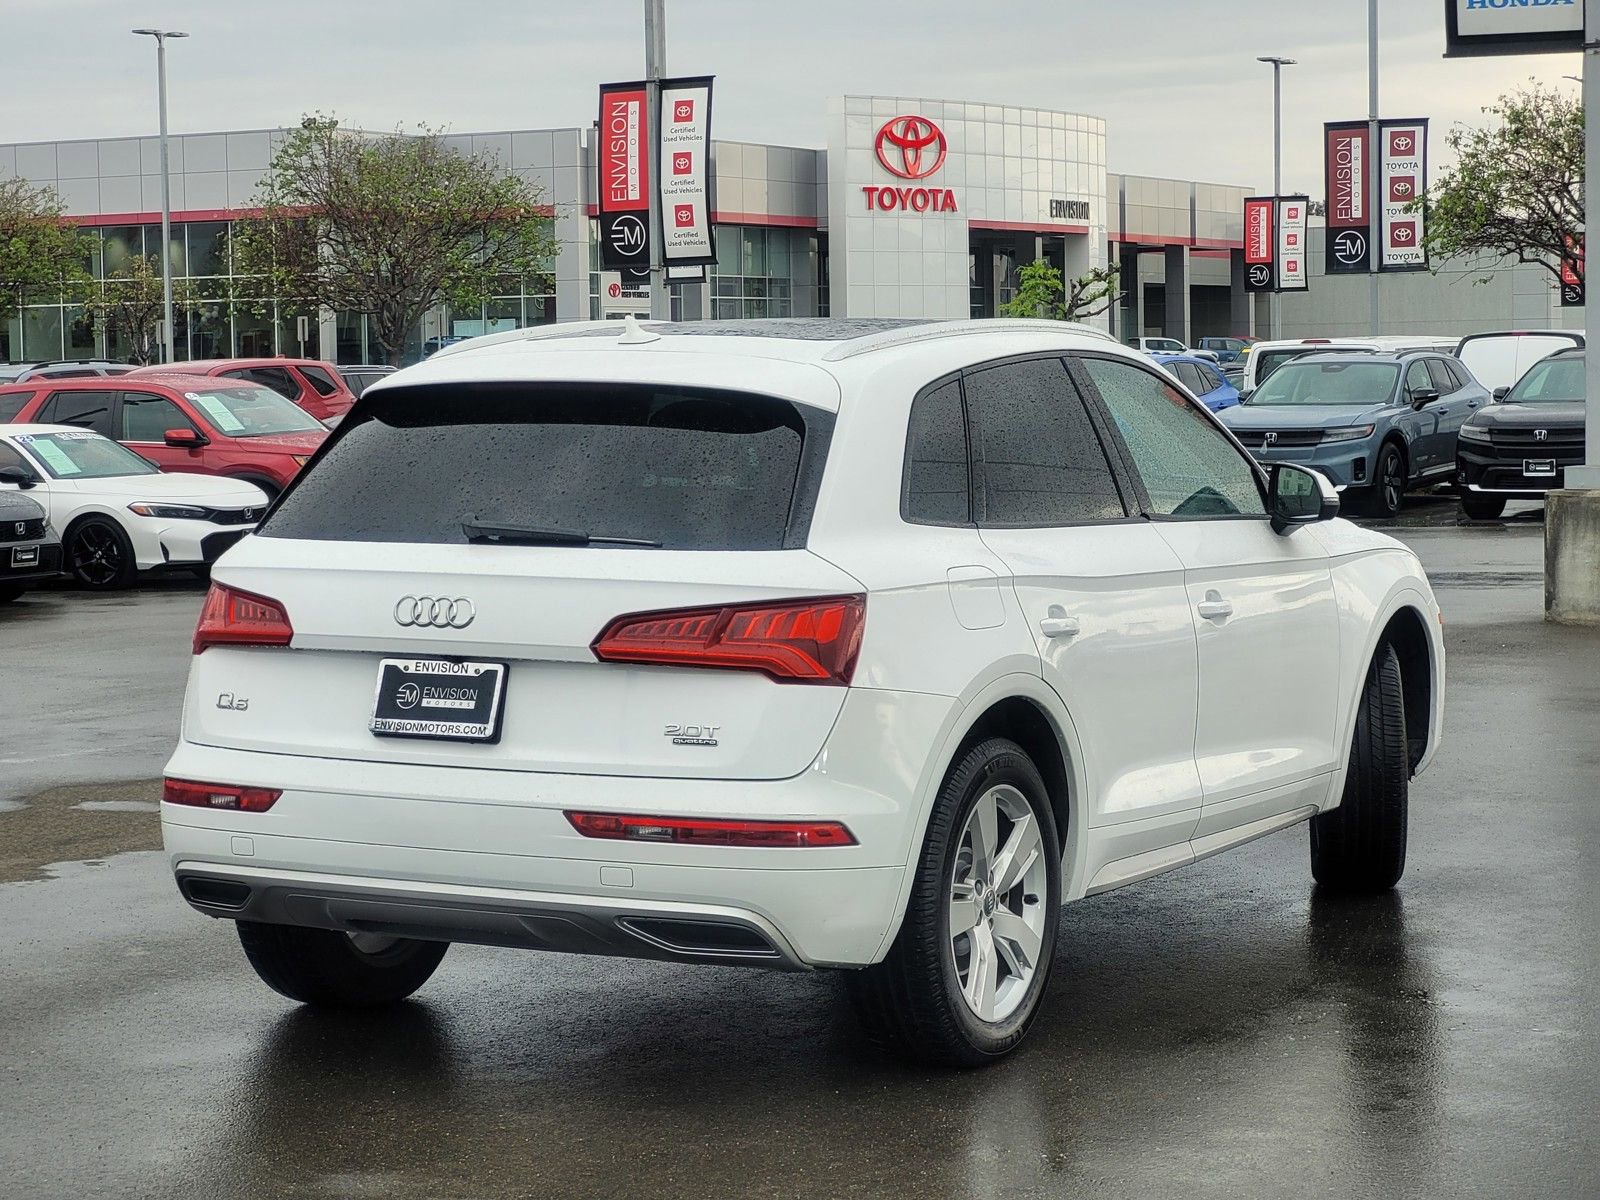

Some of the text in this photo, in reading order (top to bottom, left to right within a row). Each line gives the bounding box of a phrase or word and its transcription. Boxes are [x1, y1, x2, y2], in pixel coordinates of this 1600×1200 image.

[1466, 0, 1574, 9] HON
[679, 134, 703, 142] Vehicles
[612, 101, 627, 202] ENVISION
[1385, 162, 1419, 170] TOYOTA
[1336, 137, 1351, 219] ENVISION
[679, 186, 703, 194] Vehicles
[862, 186, 958, 212] TOYOTA
[1050, 199, 1090, 220] ENVISION
[673, 231, 699, 239] Certified
[1250, 206, 1260, 258] ENVISION
[682, 238, 707, 246] Vehicles
[1387, 253, 1421, 261] TOYOTA
[415, 661, 469, 674] ENVISION
[422, 687, 478, 700] ENVISION
[215, 692, 249, 711] Q5
[426, 700, 471, 708] MOTORS
[374, 720, 487, 735] ENVISIONMOTORS.COM
